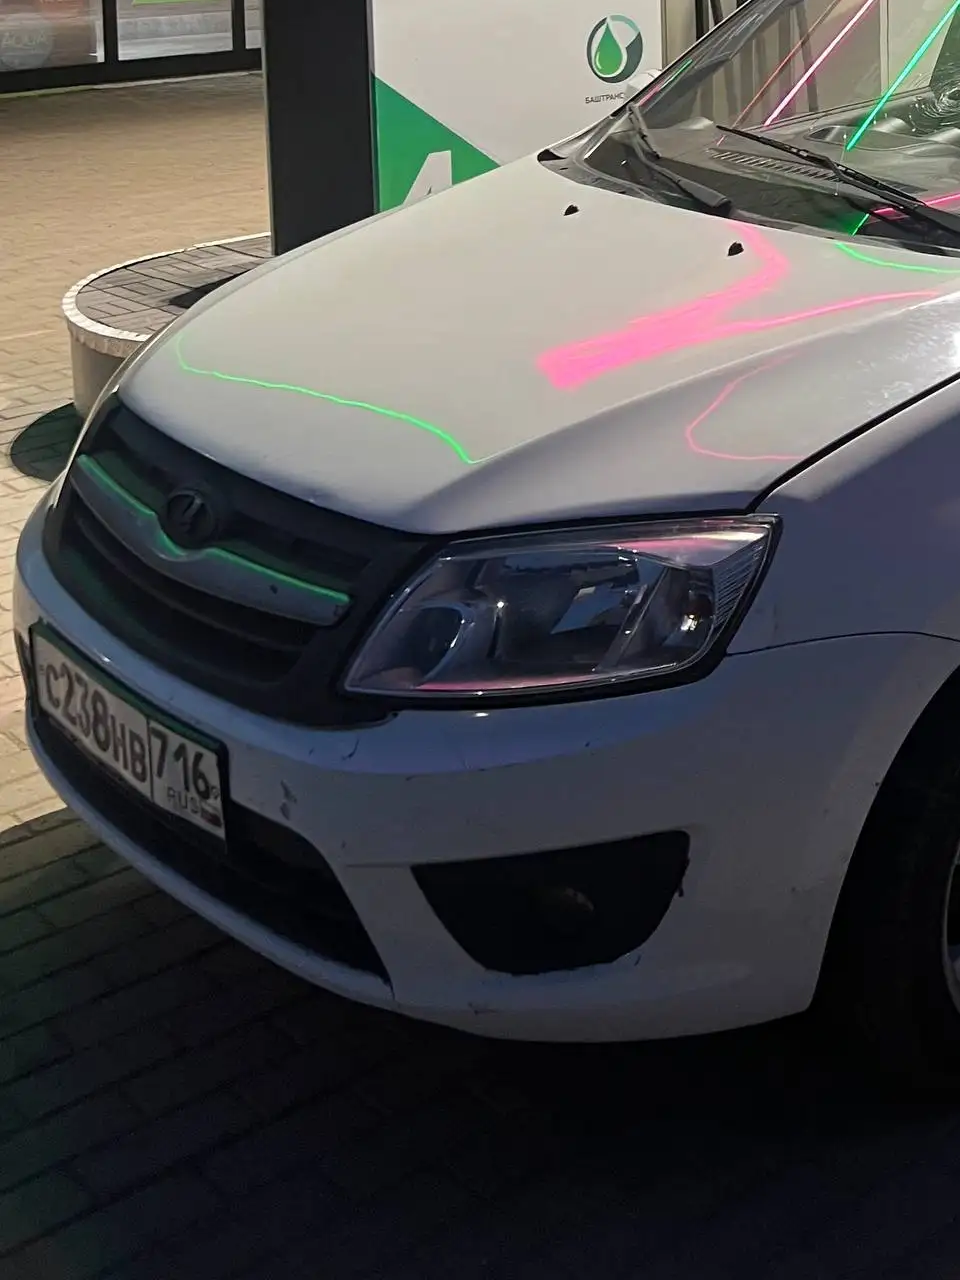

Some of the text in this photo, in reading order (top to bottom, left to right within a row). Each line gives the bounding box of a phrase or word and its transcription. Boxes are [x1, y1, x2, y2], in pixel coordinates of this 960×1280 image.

[585, 92, 626, 105] БАШТРАНС
[150, 726, 210, 801] 716
[166, 785, 200, 814] RUS
